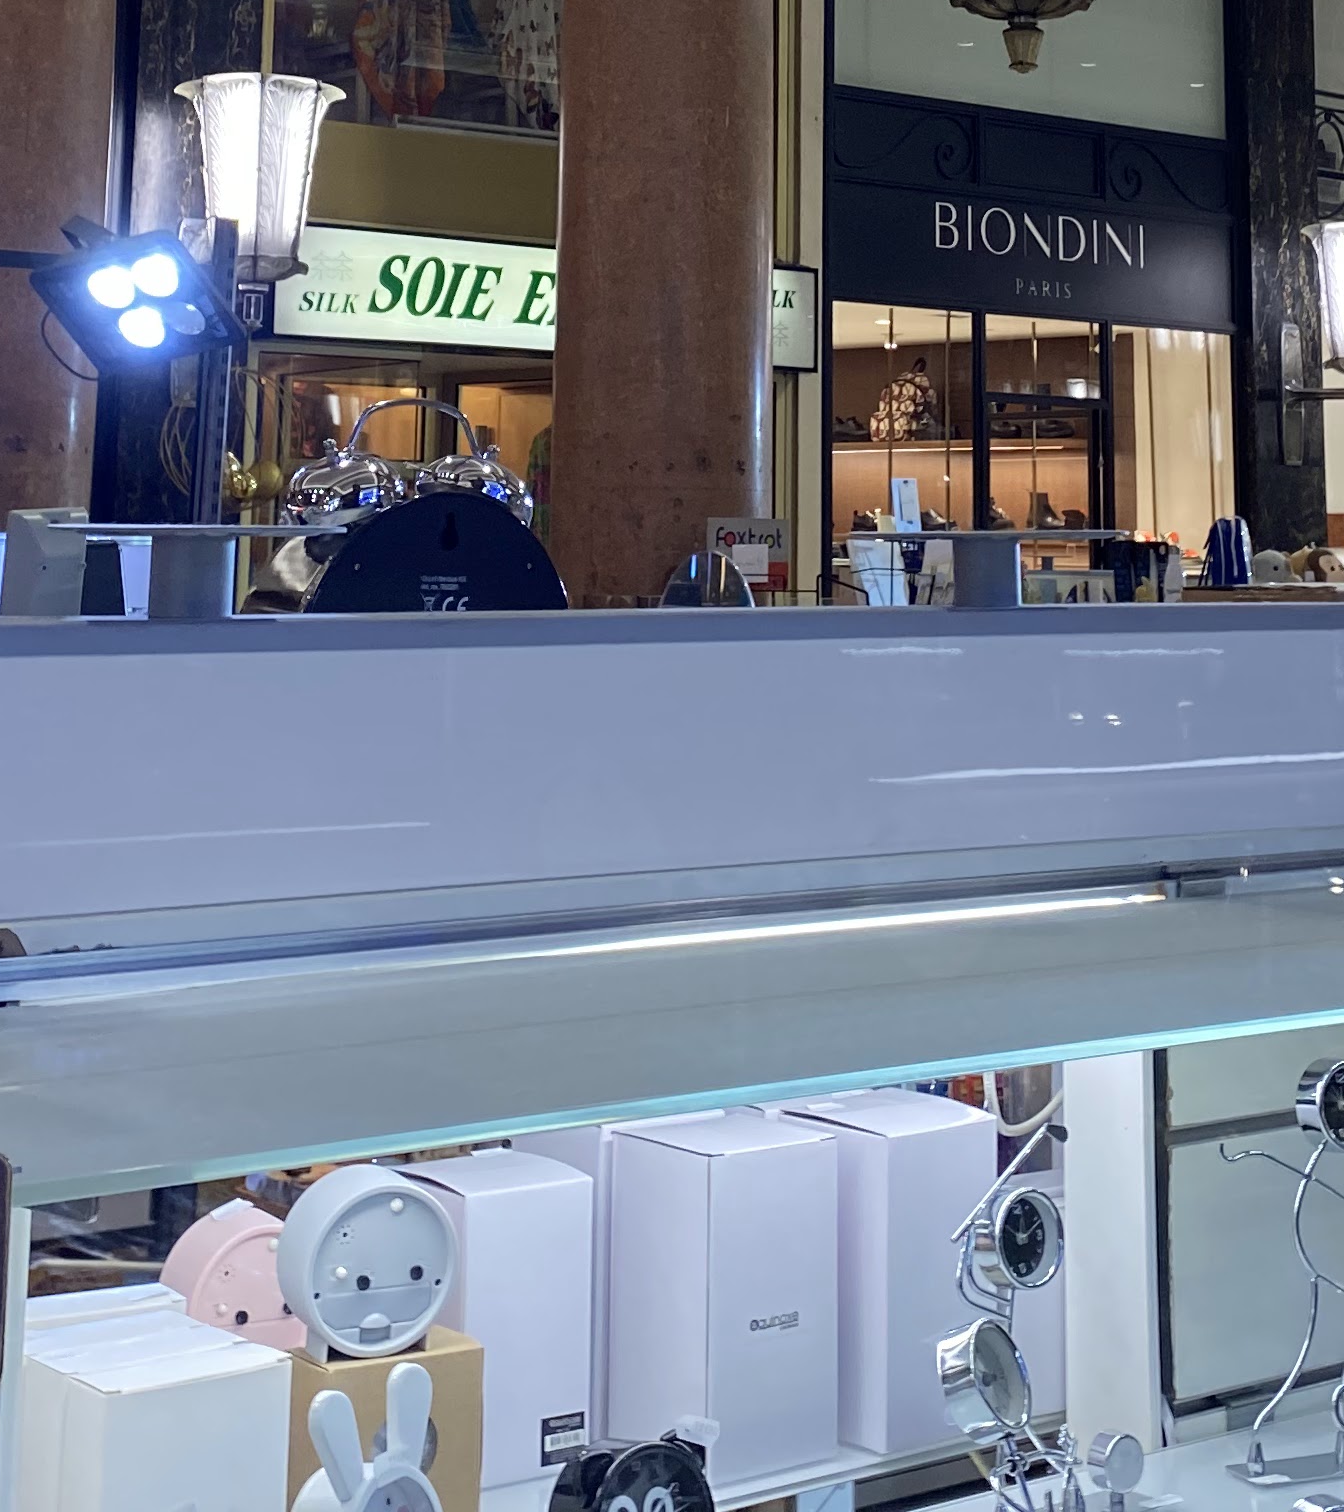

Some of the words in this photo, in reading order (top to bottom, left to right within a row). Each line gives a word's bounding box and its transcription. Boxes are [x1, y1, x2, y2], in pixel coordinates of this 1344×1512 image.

[935, 201, 1145, 269] BIONDINI
[298, 291, 360, 314] SILK
[367, 254, 503, 322] SOIE
[513, 270, 556, 326] E
[1015, 277, 1072, 299] PARIS
[716, 527, 782, 549] foxtrot
